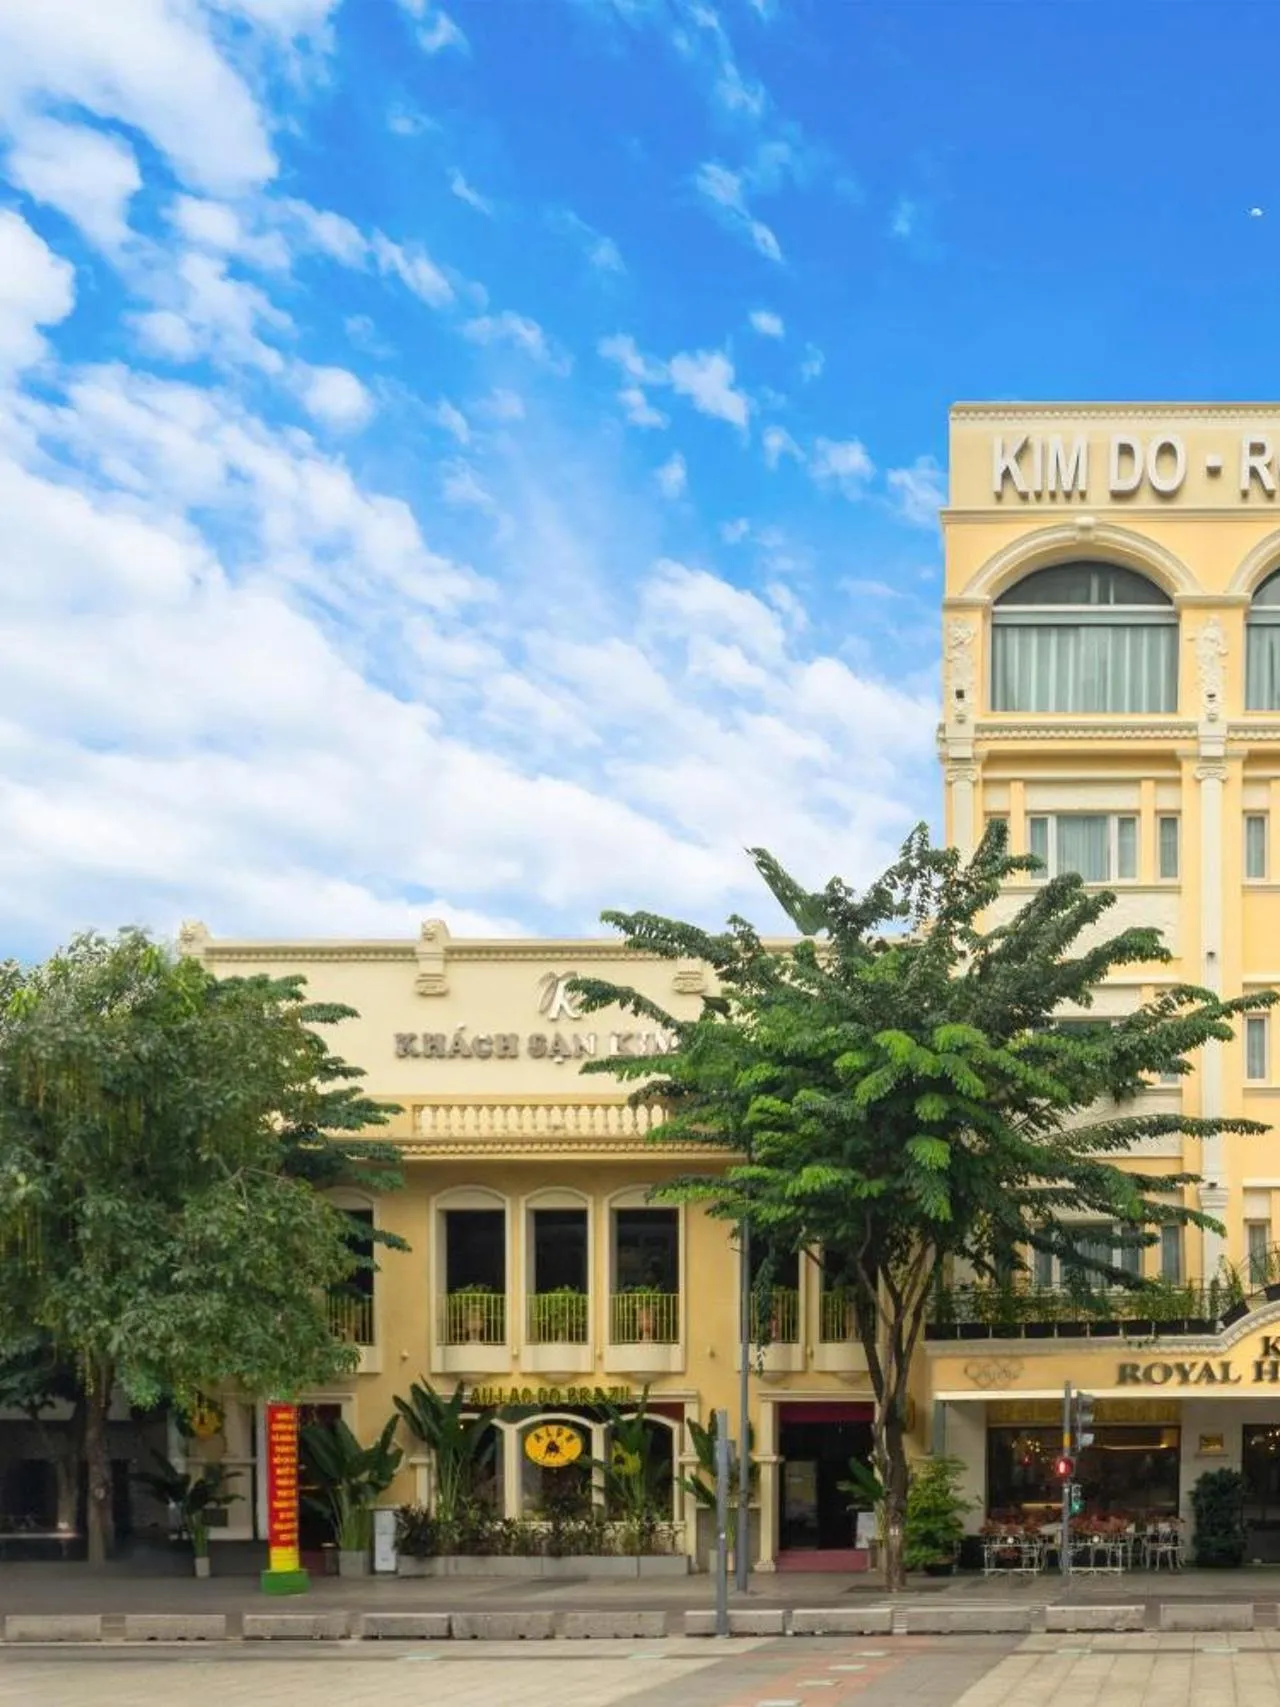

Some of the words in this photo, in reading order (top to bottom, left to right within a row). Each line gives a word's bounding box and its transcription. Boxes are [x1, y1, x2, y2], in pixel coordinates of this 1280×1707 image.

[993, 432, 1089, 498] KIM
[1108, 432, 1188, 497] DO
[394, 1022, 520, 1059] KHÁCH
[1116, 1359, 1242, 1386] ROYAL
